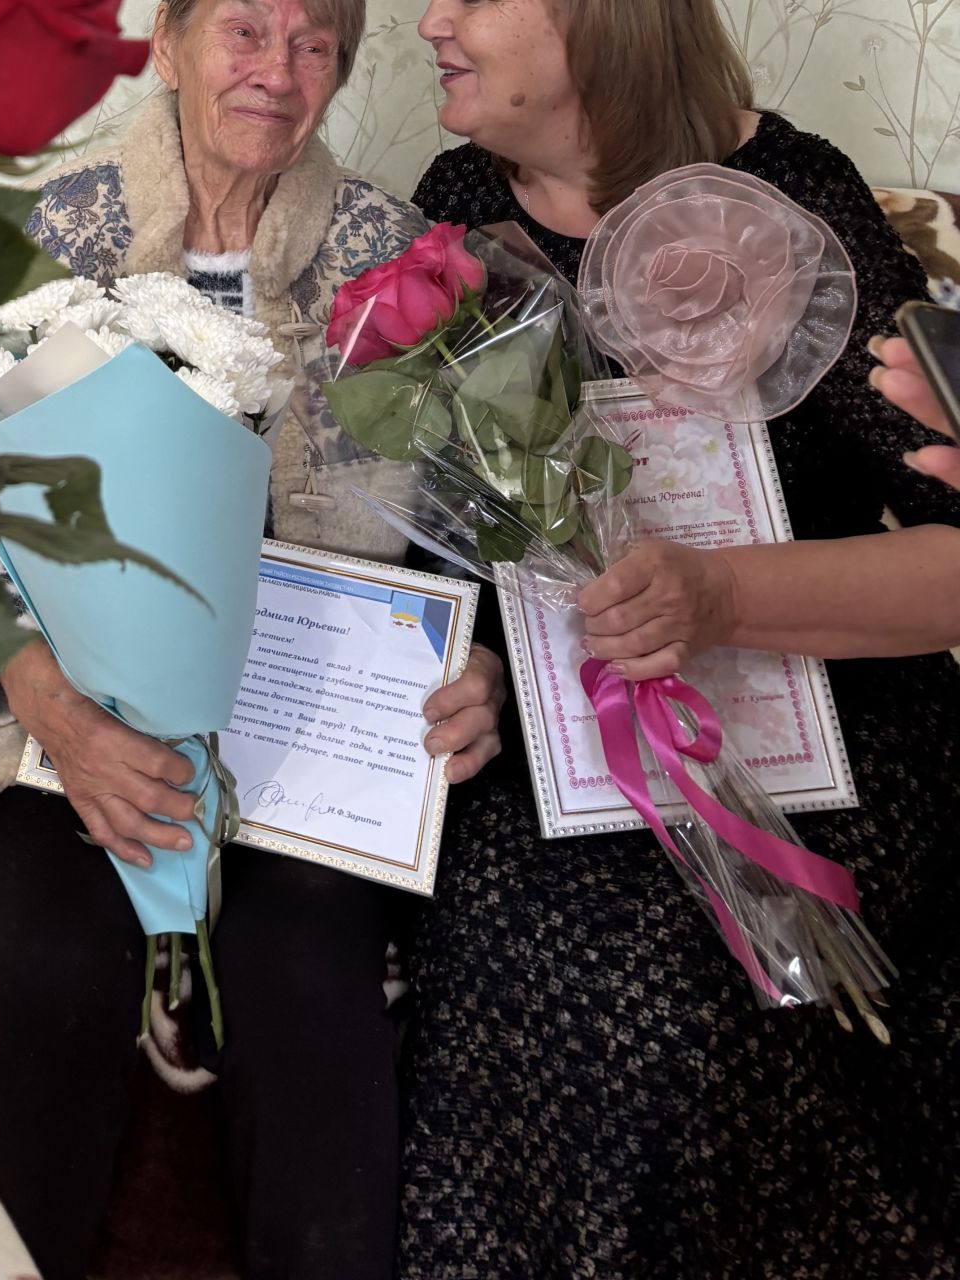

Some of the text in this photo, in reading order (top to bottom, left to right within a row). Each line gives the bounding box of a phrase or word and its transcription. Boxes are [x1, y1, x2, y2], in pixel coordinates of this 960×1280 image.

[658, 487, 705, 504] Юрьевна!
[251, 628, 295, 644] 5-летием!
[255, 607, 351, 636] юдмила Юрьевна!
[257, 645, 319, 665] значительный
[326, 661, 352, 672] вклад
[370, 671, 429, 690] процветание
[268, 663, 318, 679] восхищение
[326, 676, 364, 690] глубокое
[365, 685, 409, 701] уважение.
[251, 672, 267, 682] для
[315, 687, 364, 704] вдохновляя
[365, 700, 424, 719] окружающих
[270, 690, 339, 714] достижениями.
[232, 713, 291, 733] опутствуют
[295, 726, 312, 738] Вам
[316, 731, 346, 746] долгие
[348, 741, 373, 754] годы,
[386, 751, 417, 763] жизнь
[235, 699, 269, 712] йкость
[283, 710, 293, 718] за
[297, 712, 316, 723] Ваш
[320, 719, 346, 730] труд!
[350, 724, 378, 739] Пусть
[383, 733, 419, 749] крепкое
[253, 732, 289, 747] светлое
[291, 740, 329, 757] будущее,
[333, 752, 364, 766] полное
[367, 761, 415, 778] приятных
